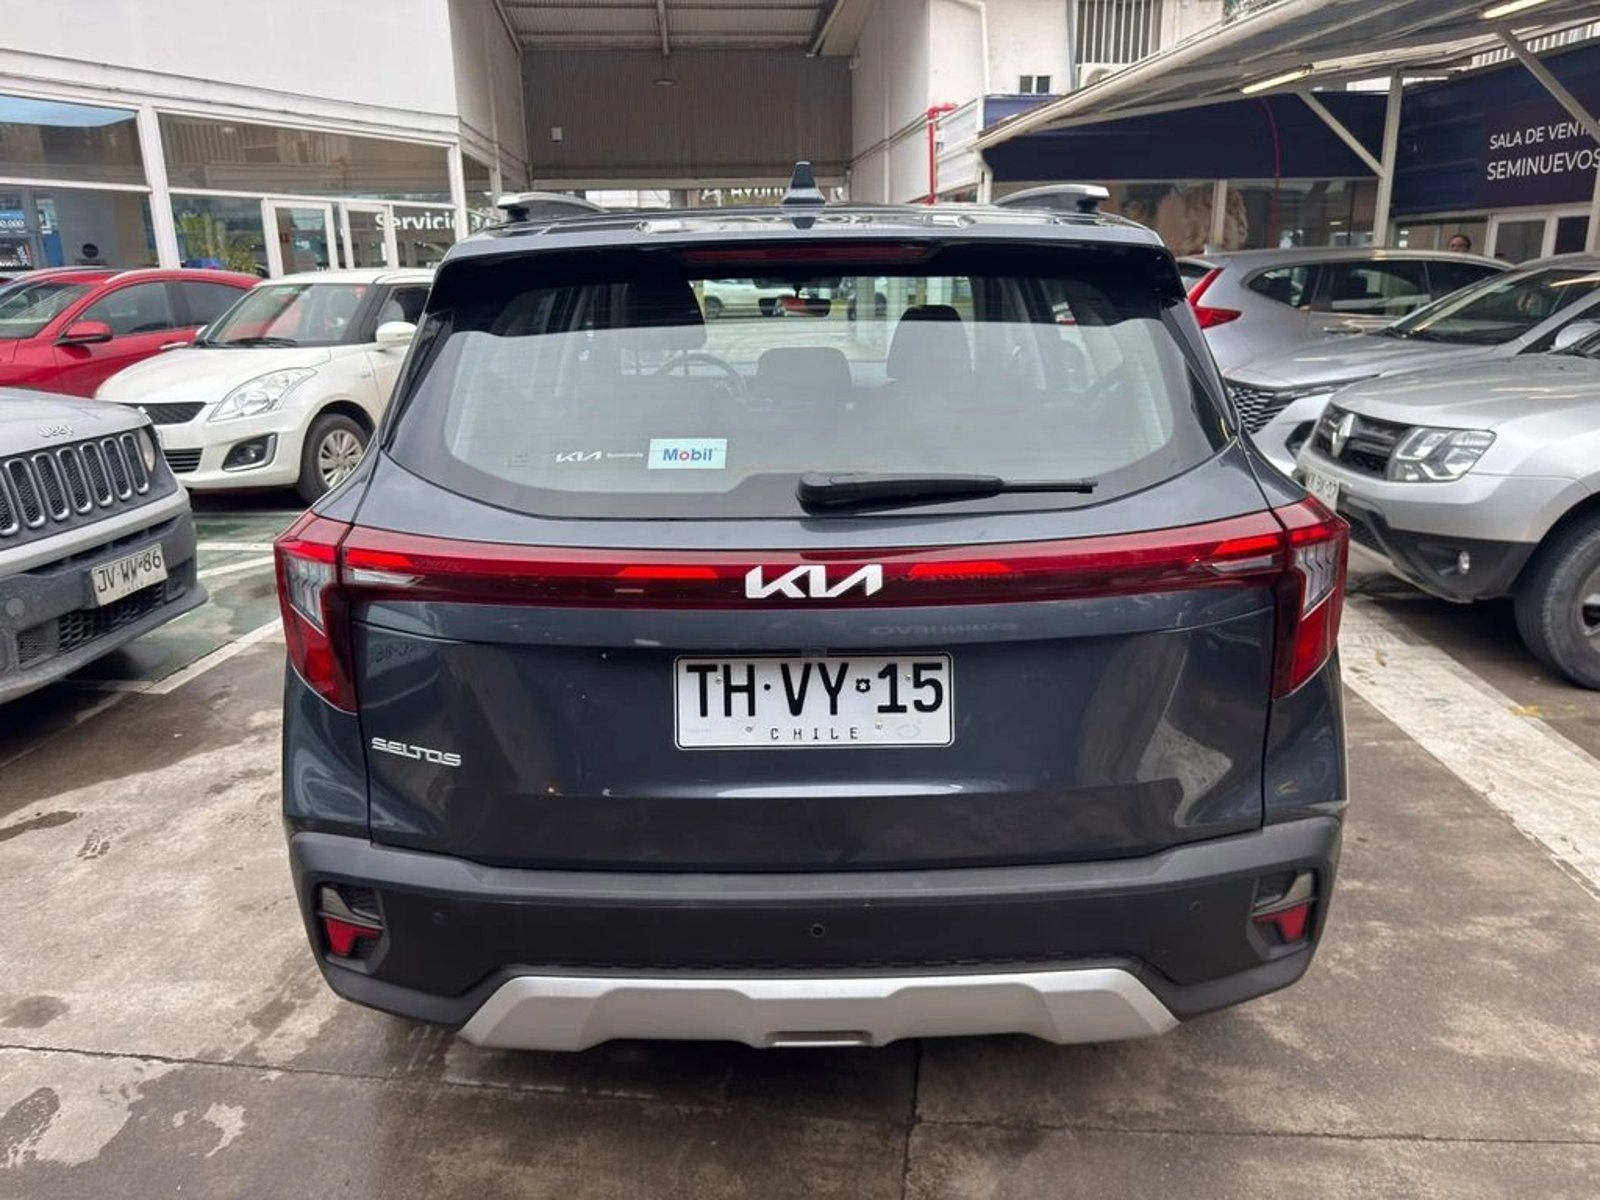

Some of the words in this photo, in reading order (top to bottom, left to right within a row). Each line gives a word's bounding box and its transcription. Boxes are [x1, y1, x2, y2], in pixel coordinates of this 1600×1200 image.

[1489, 130, 1522, 150] SALA
[1525, 125, 1545, 145] DE
[1487, 147, 1600, 181] SEMINUEVOS
[374, 211, 457, 230] Servici
[38, 424, 75, 438] Jeep
[555, 450, 603, 463] KIA
[662, 448, 713, 462] Mobil
[745, 564, 883, 599] KIA
[770, 726, 859, 741] CHILE
[371, 736, 462, 767] SELTOS
